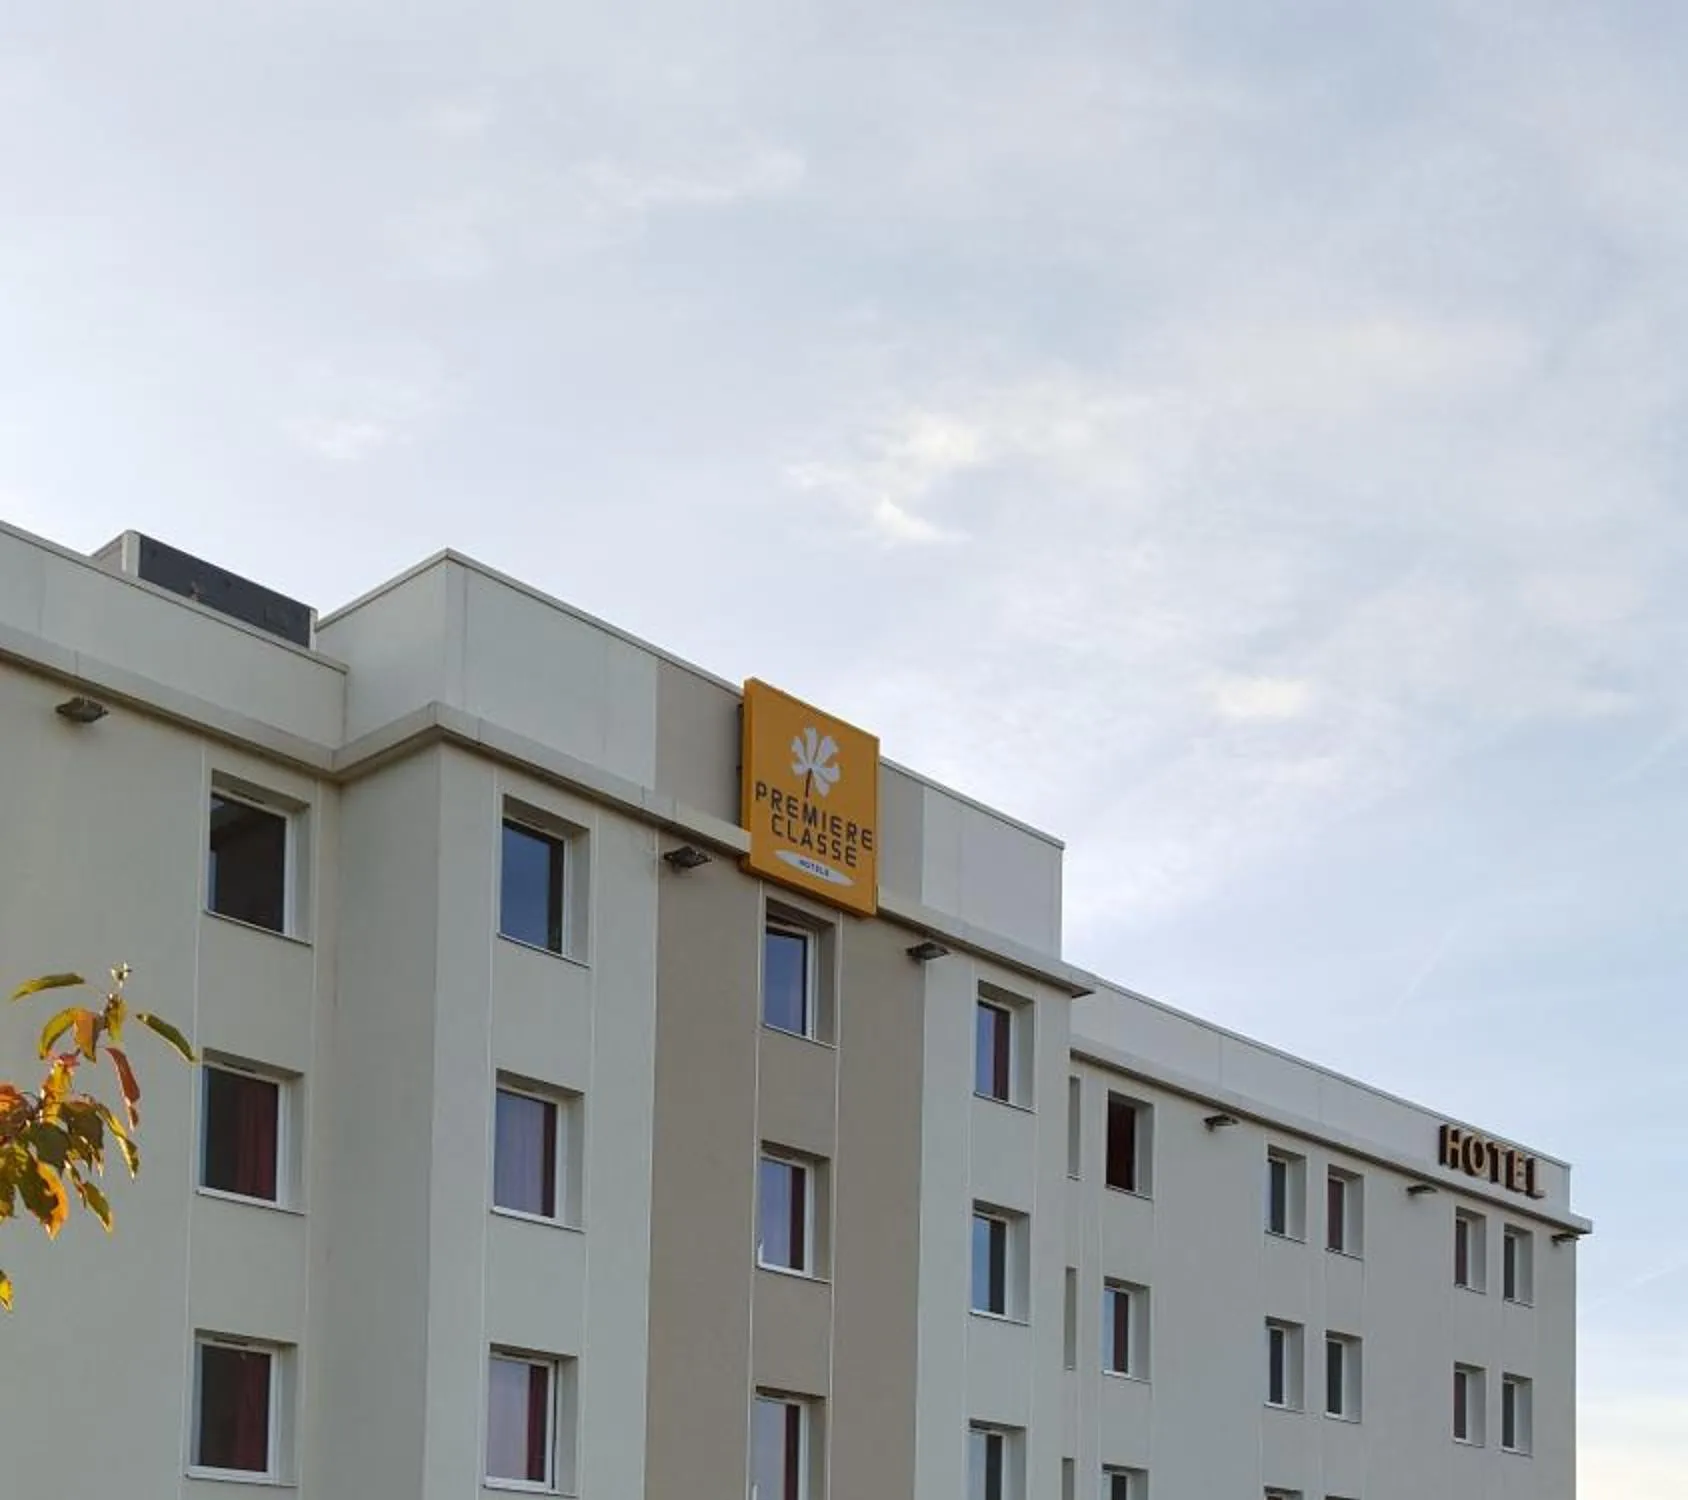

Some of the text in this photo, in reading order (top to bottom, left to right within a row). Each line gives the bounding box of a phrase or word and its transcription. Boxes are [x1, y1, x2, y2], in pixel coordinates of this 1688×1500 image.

[756, 781, 873, 850] PREMIERE
[772, 815, 857, 868] CLASSE
[1438, 1123, 1545, 1199] HOTEL
